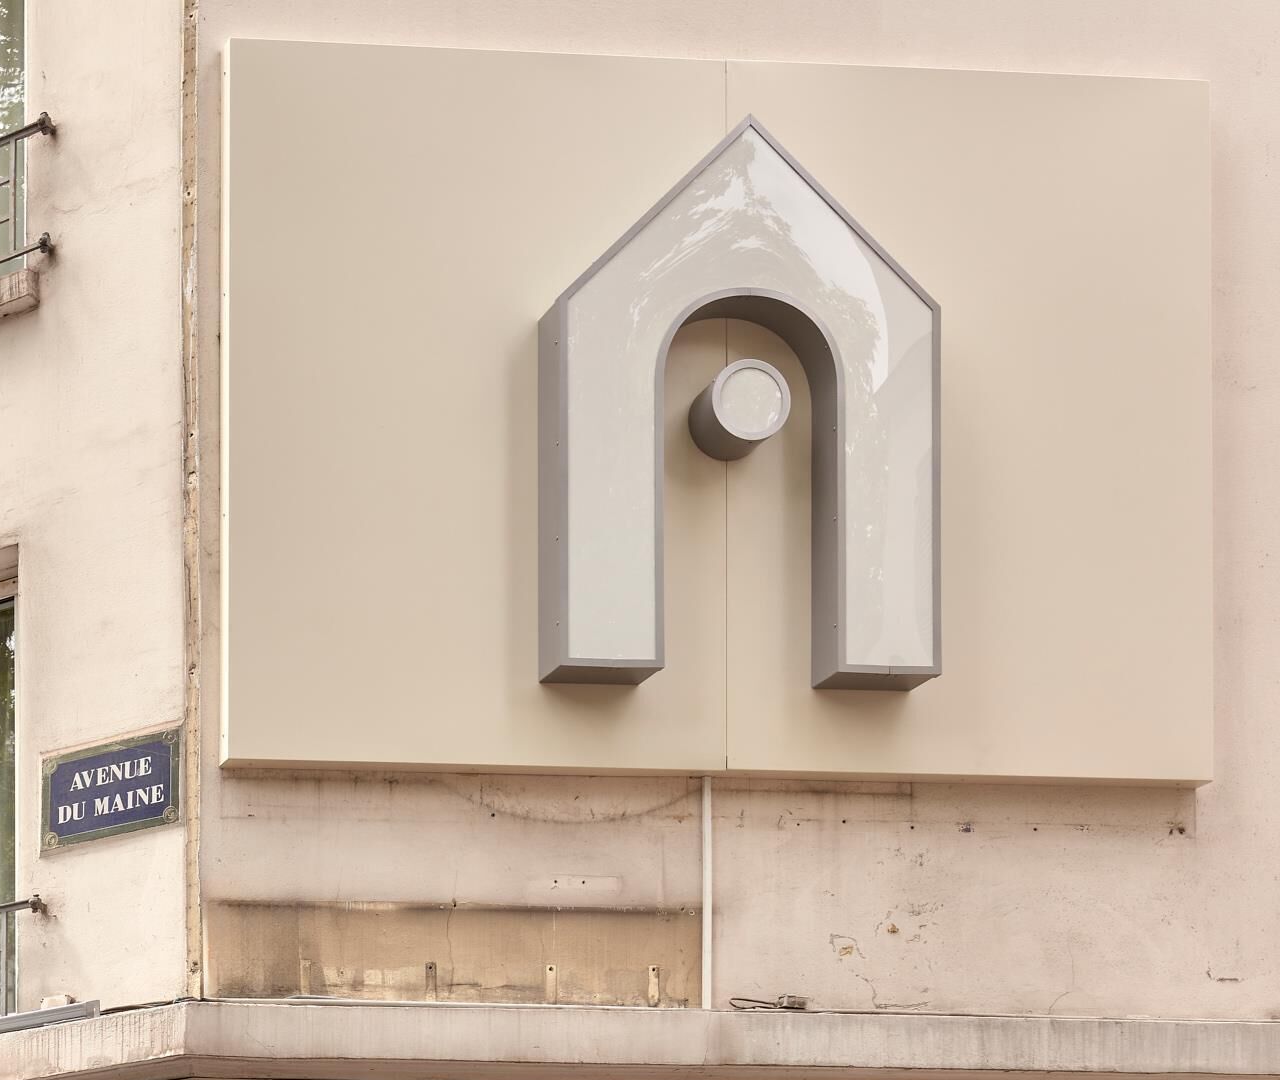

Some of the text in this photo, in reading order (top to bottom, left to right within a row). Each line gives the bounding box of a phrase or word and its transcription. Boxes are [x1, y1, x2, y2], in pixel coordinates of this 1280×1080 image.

[70, 756, 152, 792] AVENUE
[58, 784, 165, 825] DU MAINE
